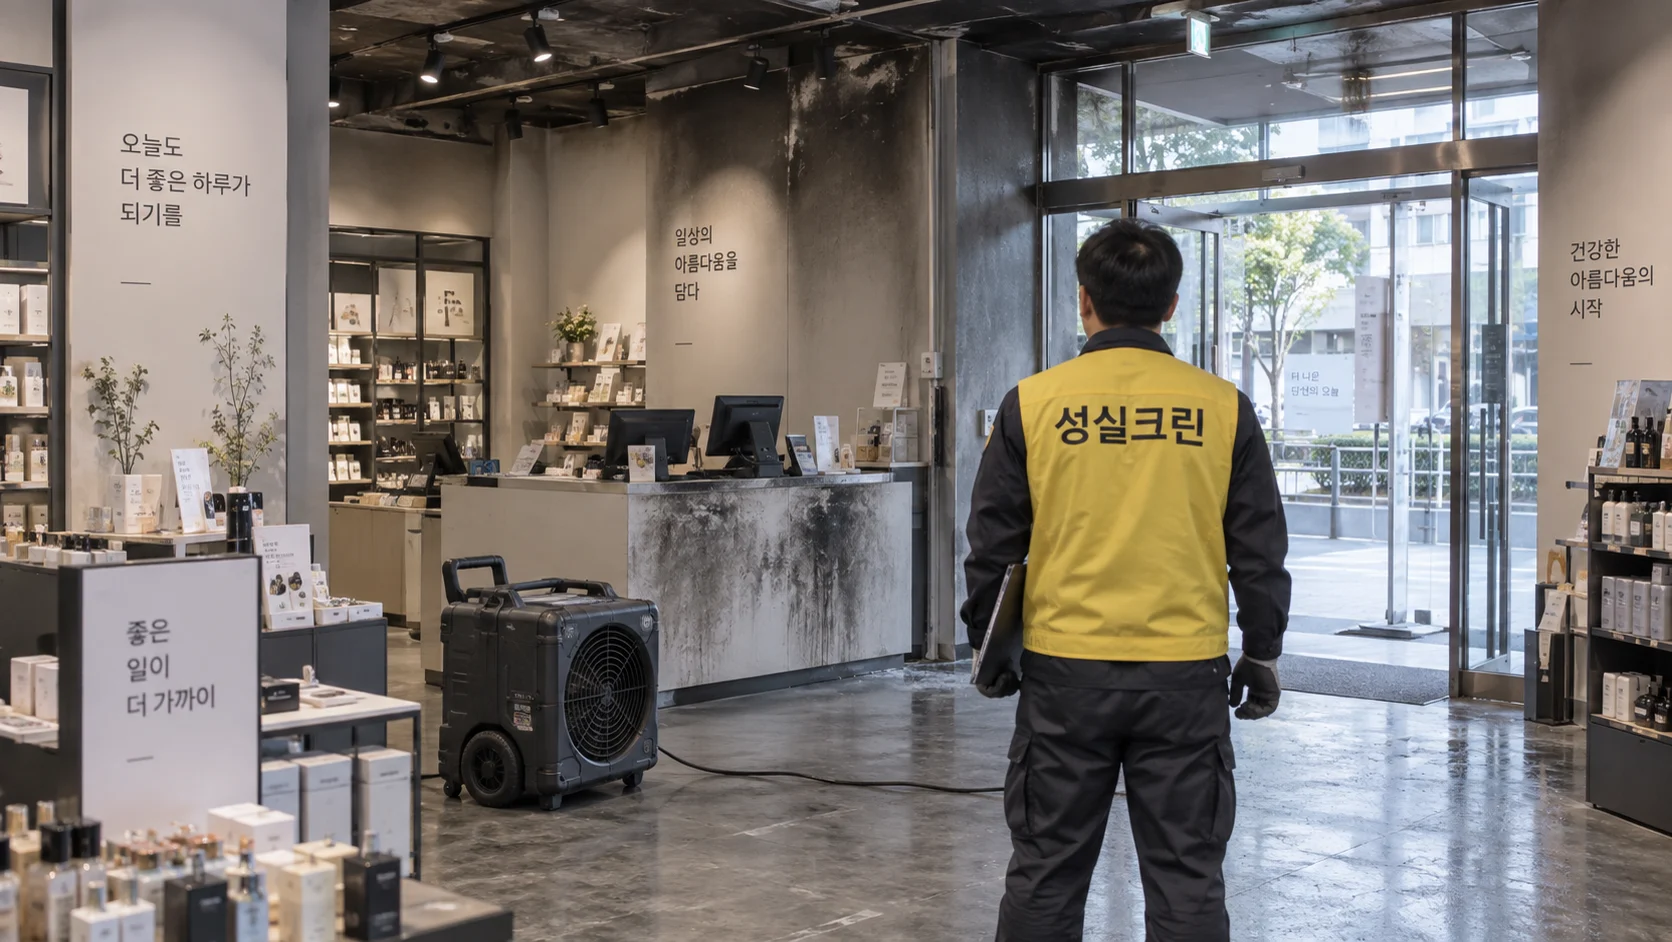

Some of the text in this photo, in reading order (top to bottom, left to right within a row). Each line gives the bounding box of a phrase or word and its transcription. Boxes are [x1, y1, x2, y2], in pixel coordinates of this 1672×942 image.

[120, 133, 184, 158] 오늘도
[121, 167, 252, 198] 더 좋은 하루가
[120, 202, 183, 228] 되기를
[675, 225, 712, 247] 일상의
[674, 250, 738, 274] 아름다움을
[1570, 238, 1621, 263] 건강한
[1570, 264, 1655, 290] 아름다움의
[674, 281, 700, 302] 담다
[1570, 298, 1603, 319] 시작
[1055, 405, 1204, 448] 성실크린
[127, 618, 171, 647] 좋은
[127, 654, 170, 682] 일이
[127, 684, 216, 717] 더 가까이
